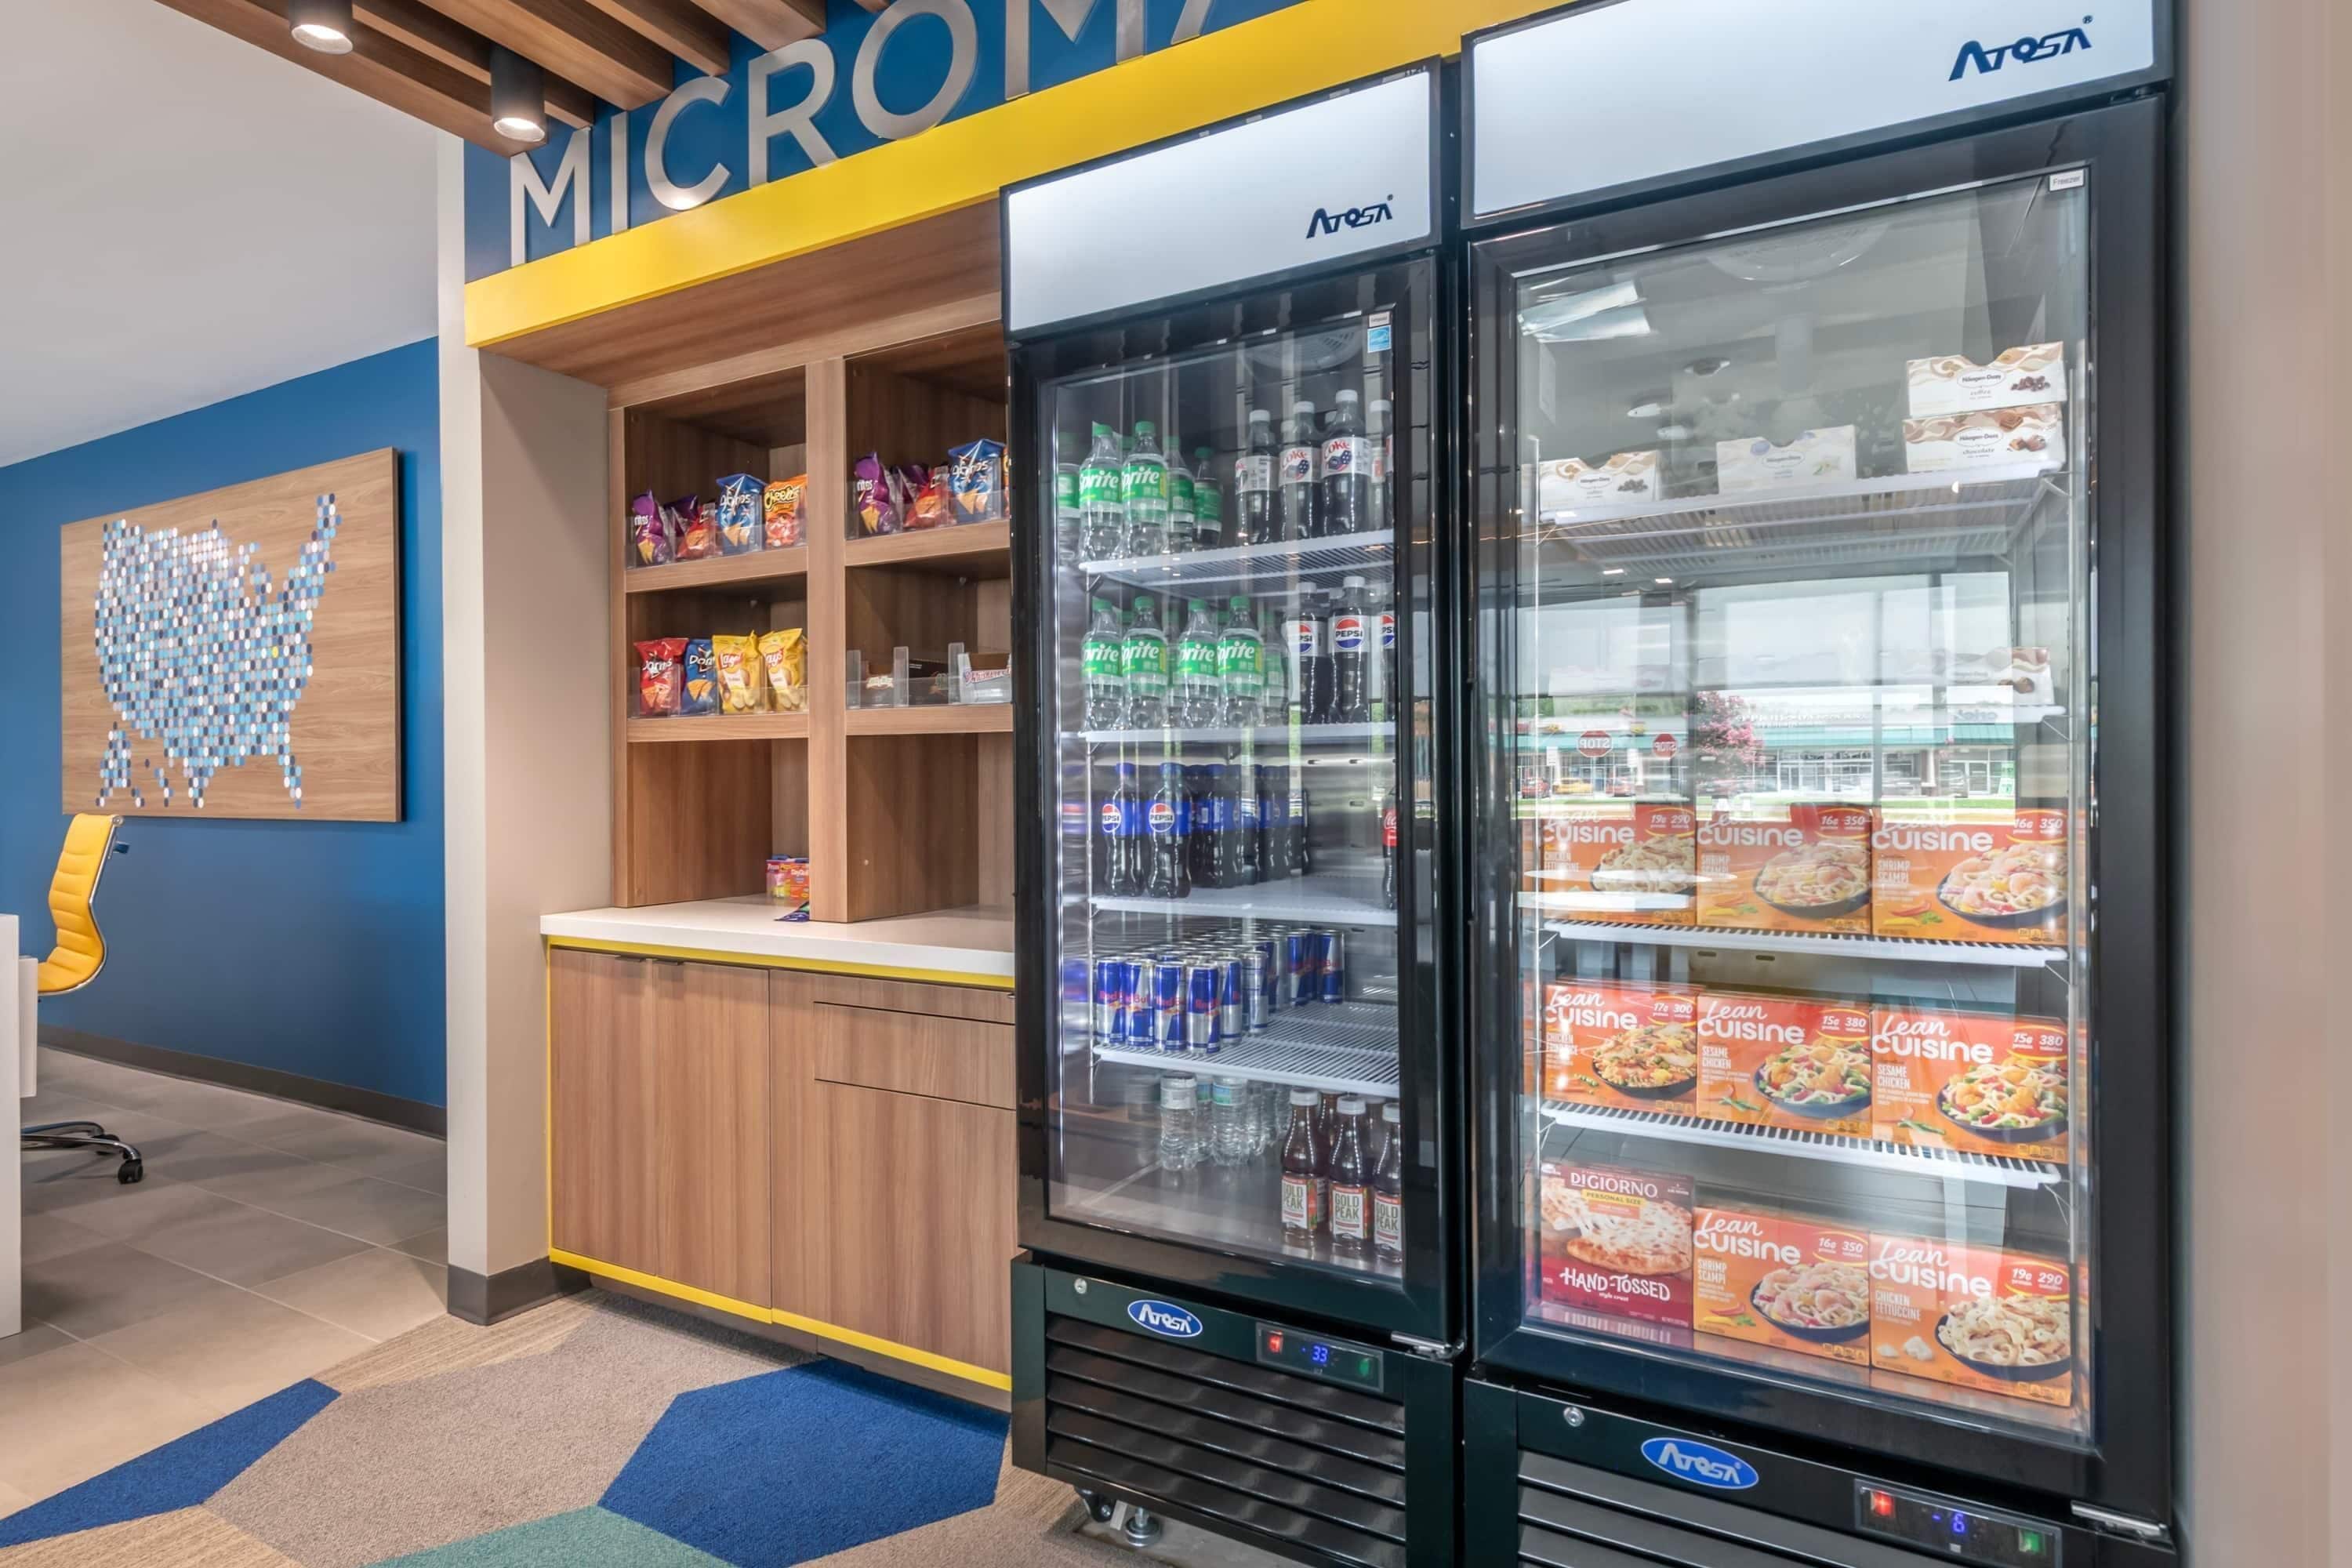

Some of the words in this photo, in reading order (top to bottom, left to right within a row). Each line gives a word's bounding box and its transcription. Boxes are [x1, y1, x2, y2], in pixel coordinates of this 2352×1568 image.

[510, 0, 1221, 267] MICROM
[1670, 815, 1691, 824] 290
[1844, 815, 1866, 826] 350
[2039, 818, 2063, 829] 350
[1673, 1003, 1693, 1014] 300
[1707, 1000, 1768, 1022] Lean
[1845, 1017, 1867, 1028] 380
[1882, 1015, 1951, 1036] Lean
[2039, 1034, 2064, 1047] 380
[1702, 1046, 1728, 1058] SESAME
[1702, 1058, 1731, 1069] CHICKEN
[1878, 1064, 1907, 1079] SESAME
[1878, 1076, 1911, 1090] CHICKEN
[1334, 1192, 1359, 1207] GOLD
[1586, 1192, 1624, 1203] PERSONAL
[1626, 1197, 1642, 1206] SIZE
[1335, 1205, 1359, 1220] PEAK
[1700, 1212, 1763, 1236] Lean
[1842, 1241, 1864, 1254] 350
[1878, 1241, 1950, 1266] Lean
[1697, 1258, 1727, 1273] SHRIMP
[1559, 1266, 1671, 1301] HAND-TOSSED
[1697, 1269, 1726, 1286] SCAMPI
[2037, 1272, 2063, 1286] 290
[1875, 1289, 1911, 1306] CHICKEN
[1312, 1345, 1328, 1363] 33
